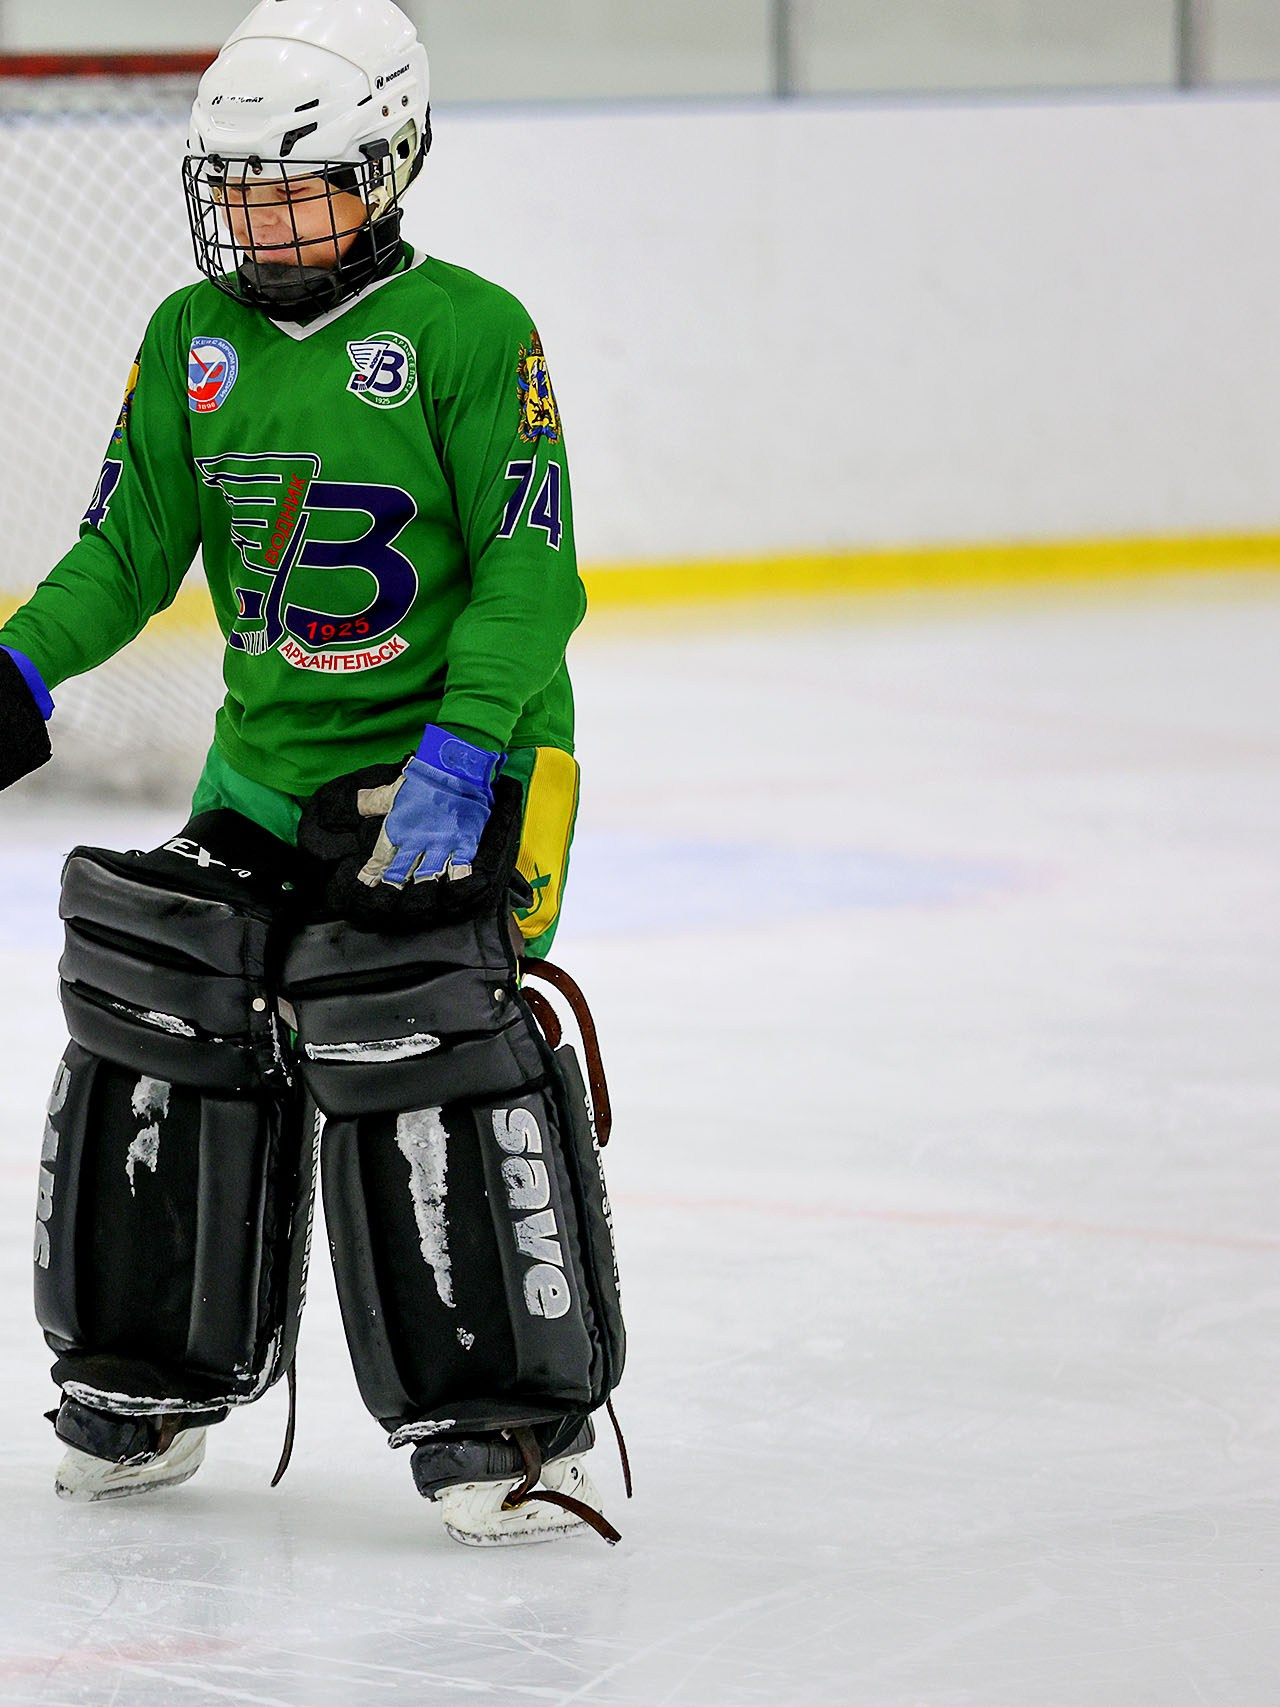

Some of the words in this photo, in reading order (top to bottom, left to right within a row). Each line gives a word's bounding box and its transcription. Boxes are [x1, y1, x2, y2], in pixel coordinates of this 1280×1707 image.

[81, 458, 124, 531] 4
[264, 473, 307, 566] ВОДНИК
[495, 453, 564, 552] 74
[280, 636, 406, 671] АРХАНГЕЛЬСК
[306, 617, 370, 641] 1925
[491, 1107, 571, 1320] save
